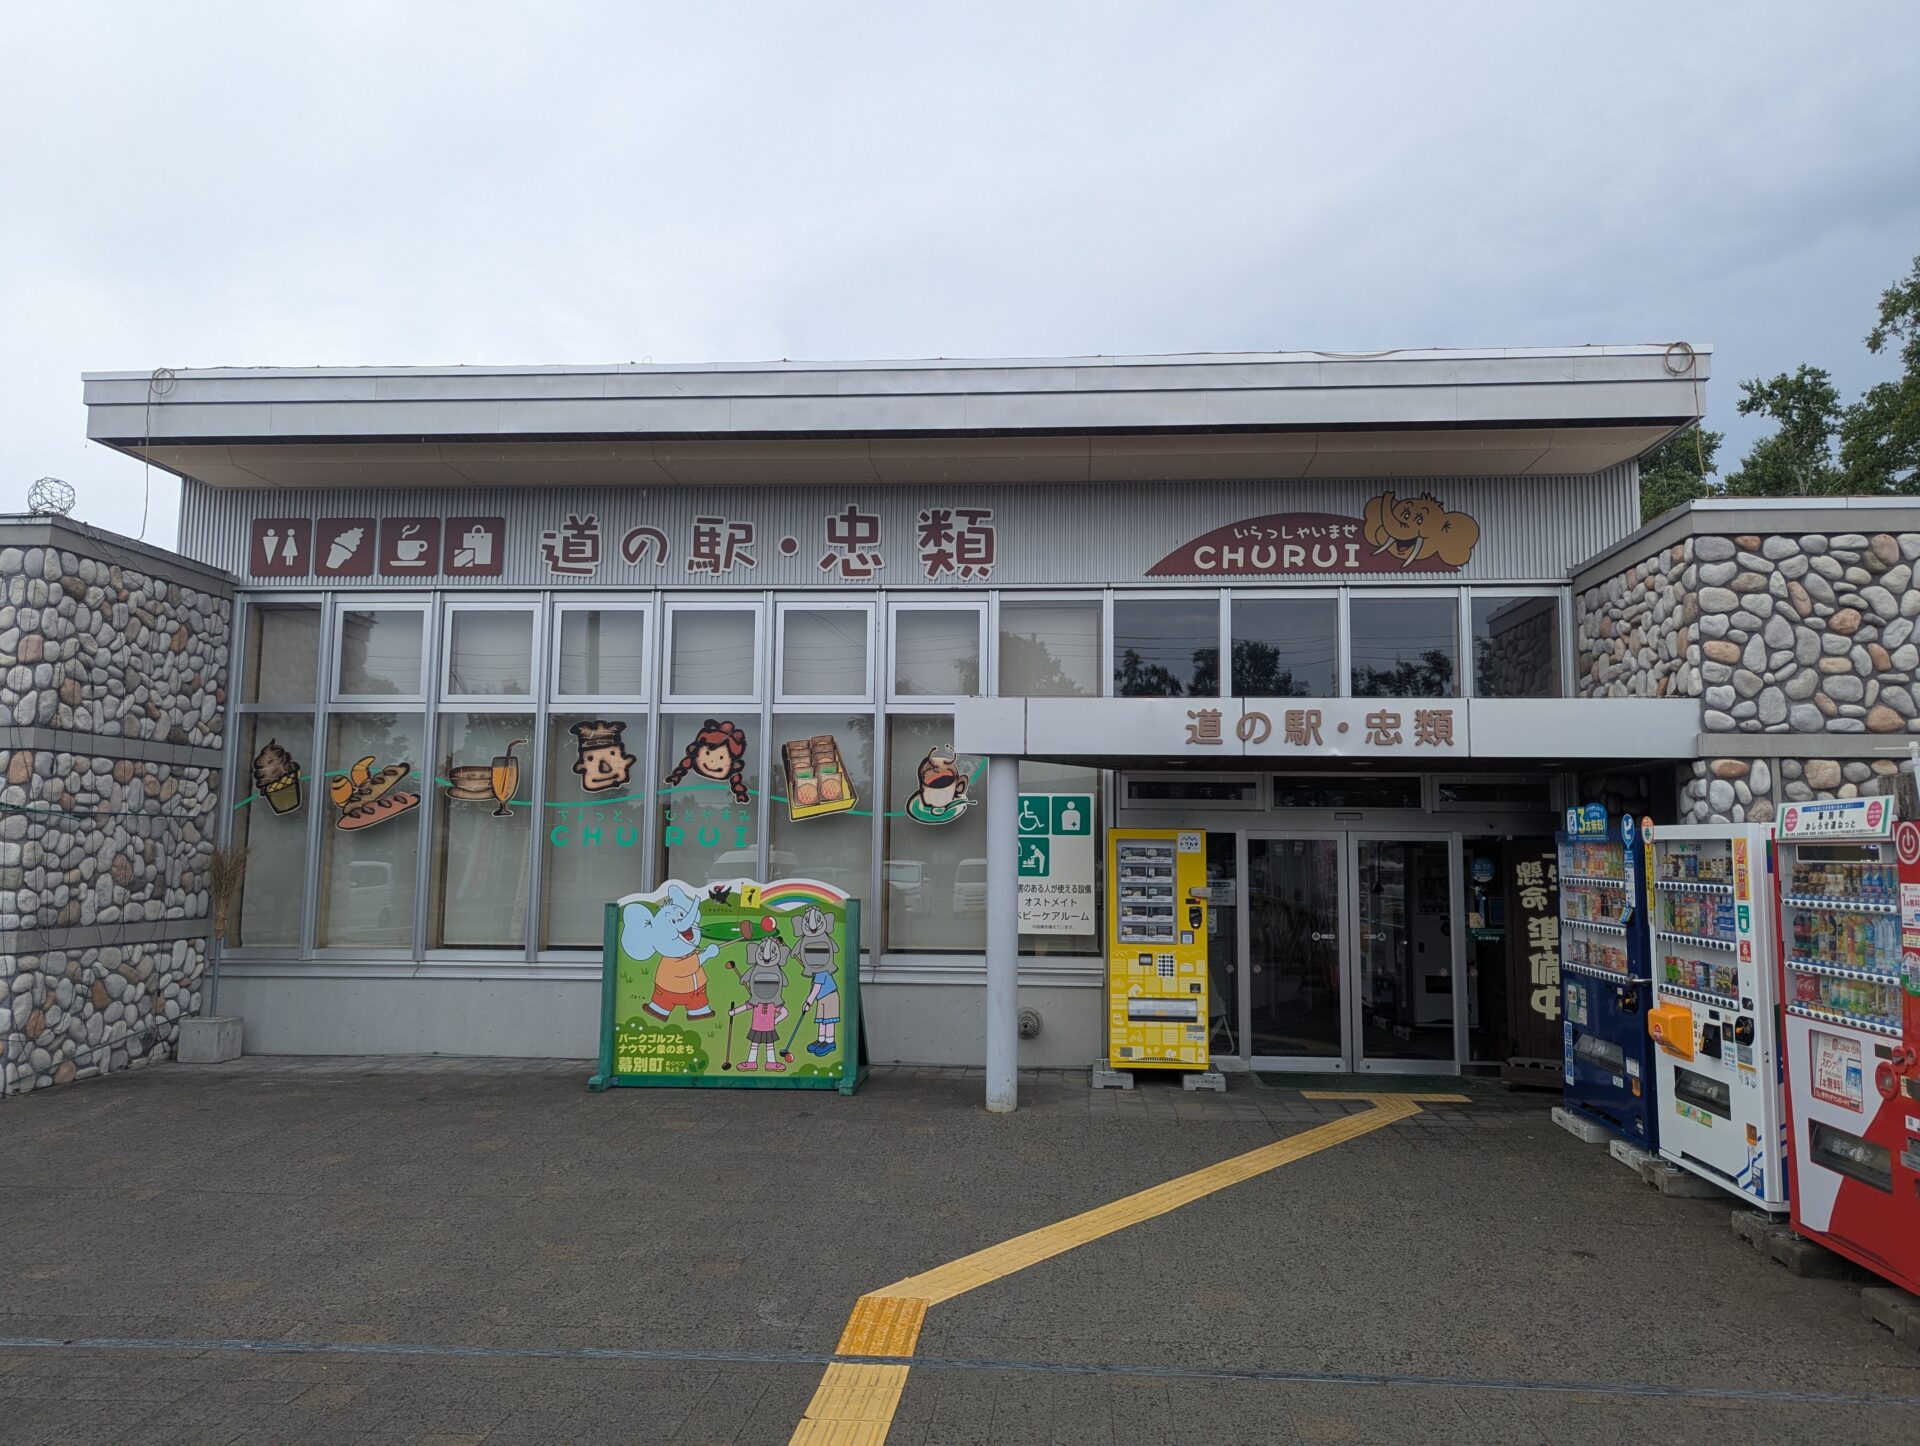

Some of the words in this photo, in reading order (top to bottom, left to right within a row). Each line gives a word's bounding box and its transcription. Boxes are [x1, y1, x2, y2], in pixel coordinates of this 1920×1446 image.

[1233, 524, 1358, 540] いらっしゃいませ
[541, 503, 997, 580] 道の駅・忠類
[1194, 543, 1360, 569] CHURUI
[1185, 708, 1454, 746] 道の駅・忠類
[558, 809, 633, 823] ちょっと、
[664, 809, 749, 822] ひとやすみ
[1024, 897, 1078, 907] オストメイト
[618, 1033, 683, 1043] パークゴルフと
[618, 1044, 694, 1054] ナウマン象のまち
[618, 1056, 664, 1072] 幕別町
